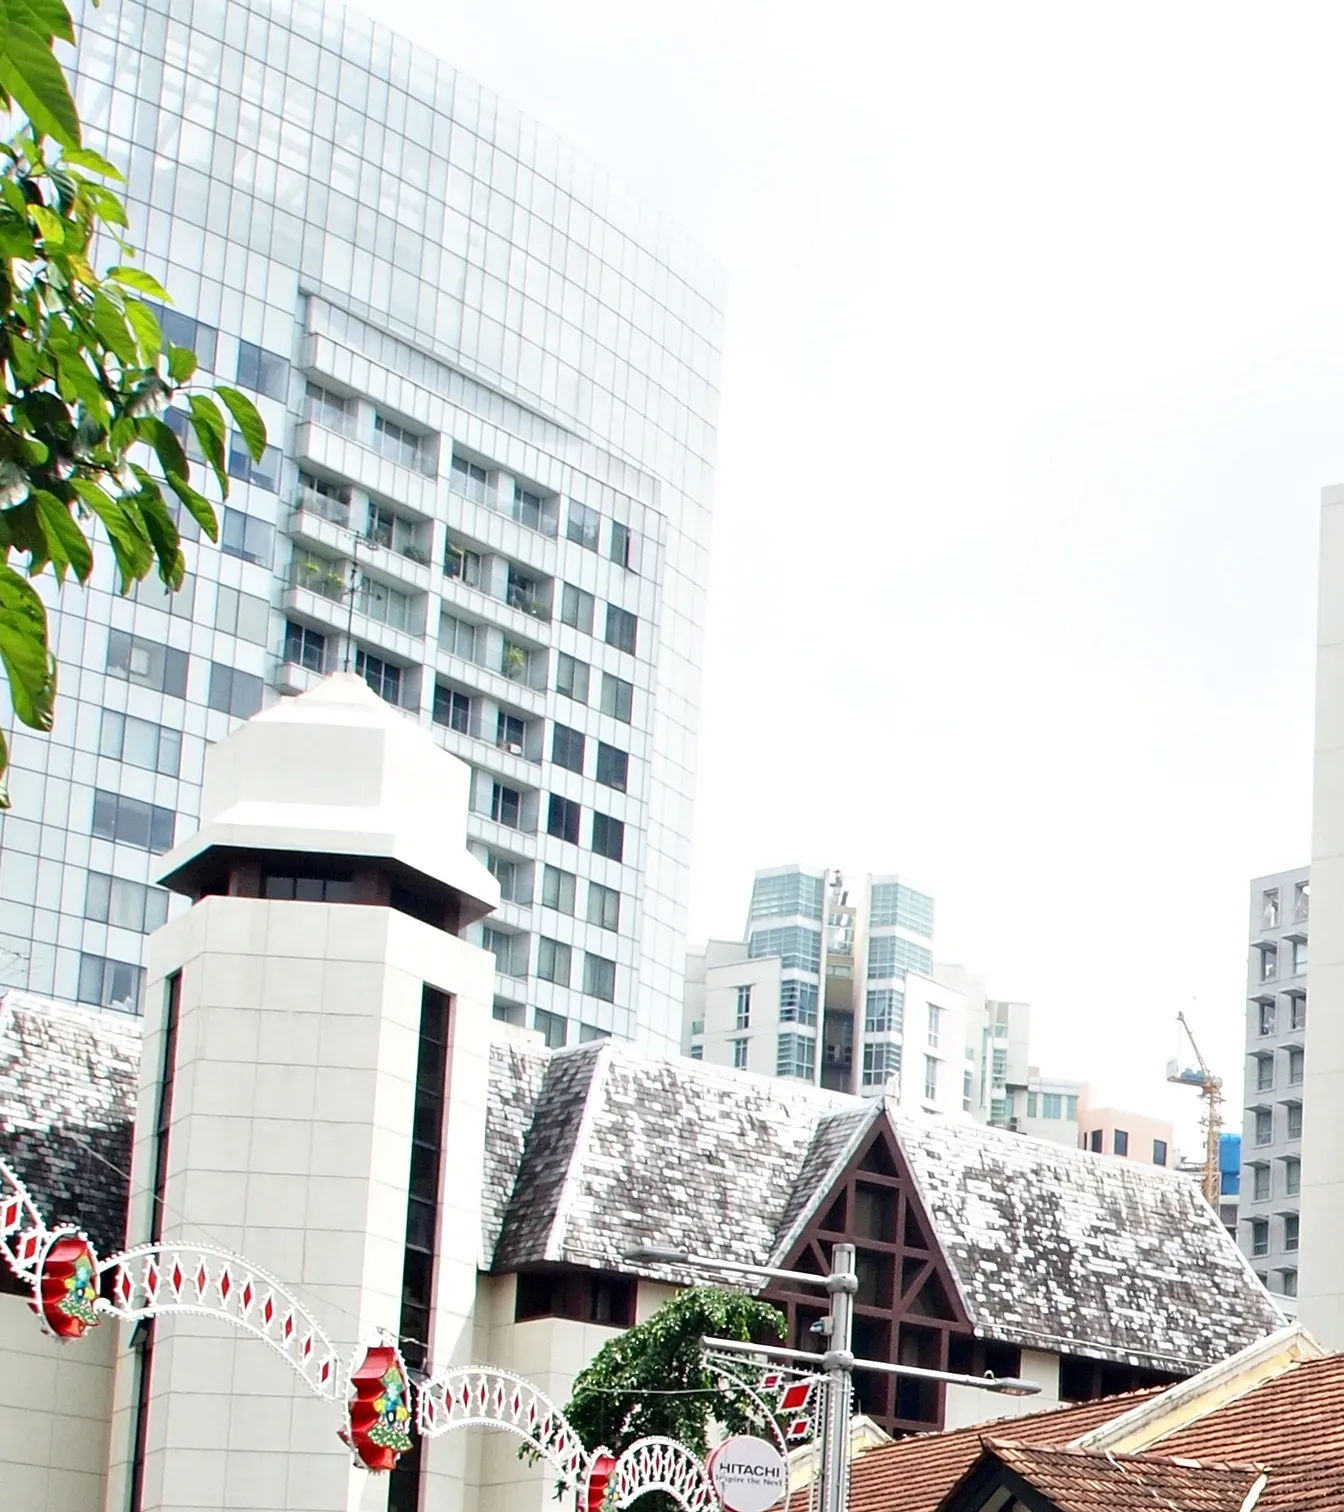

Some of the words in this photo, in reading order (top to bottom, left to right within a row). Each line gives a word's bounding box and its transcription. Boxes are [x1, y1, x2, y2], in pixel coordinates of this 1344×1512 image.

[720, 1462, 780, 1478] HITACHI
[746, 1477, 760, 1485] the
[763, 1479, 783, 1487] Next
